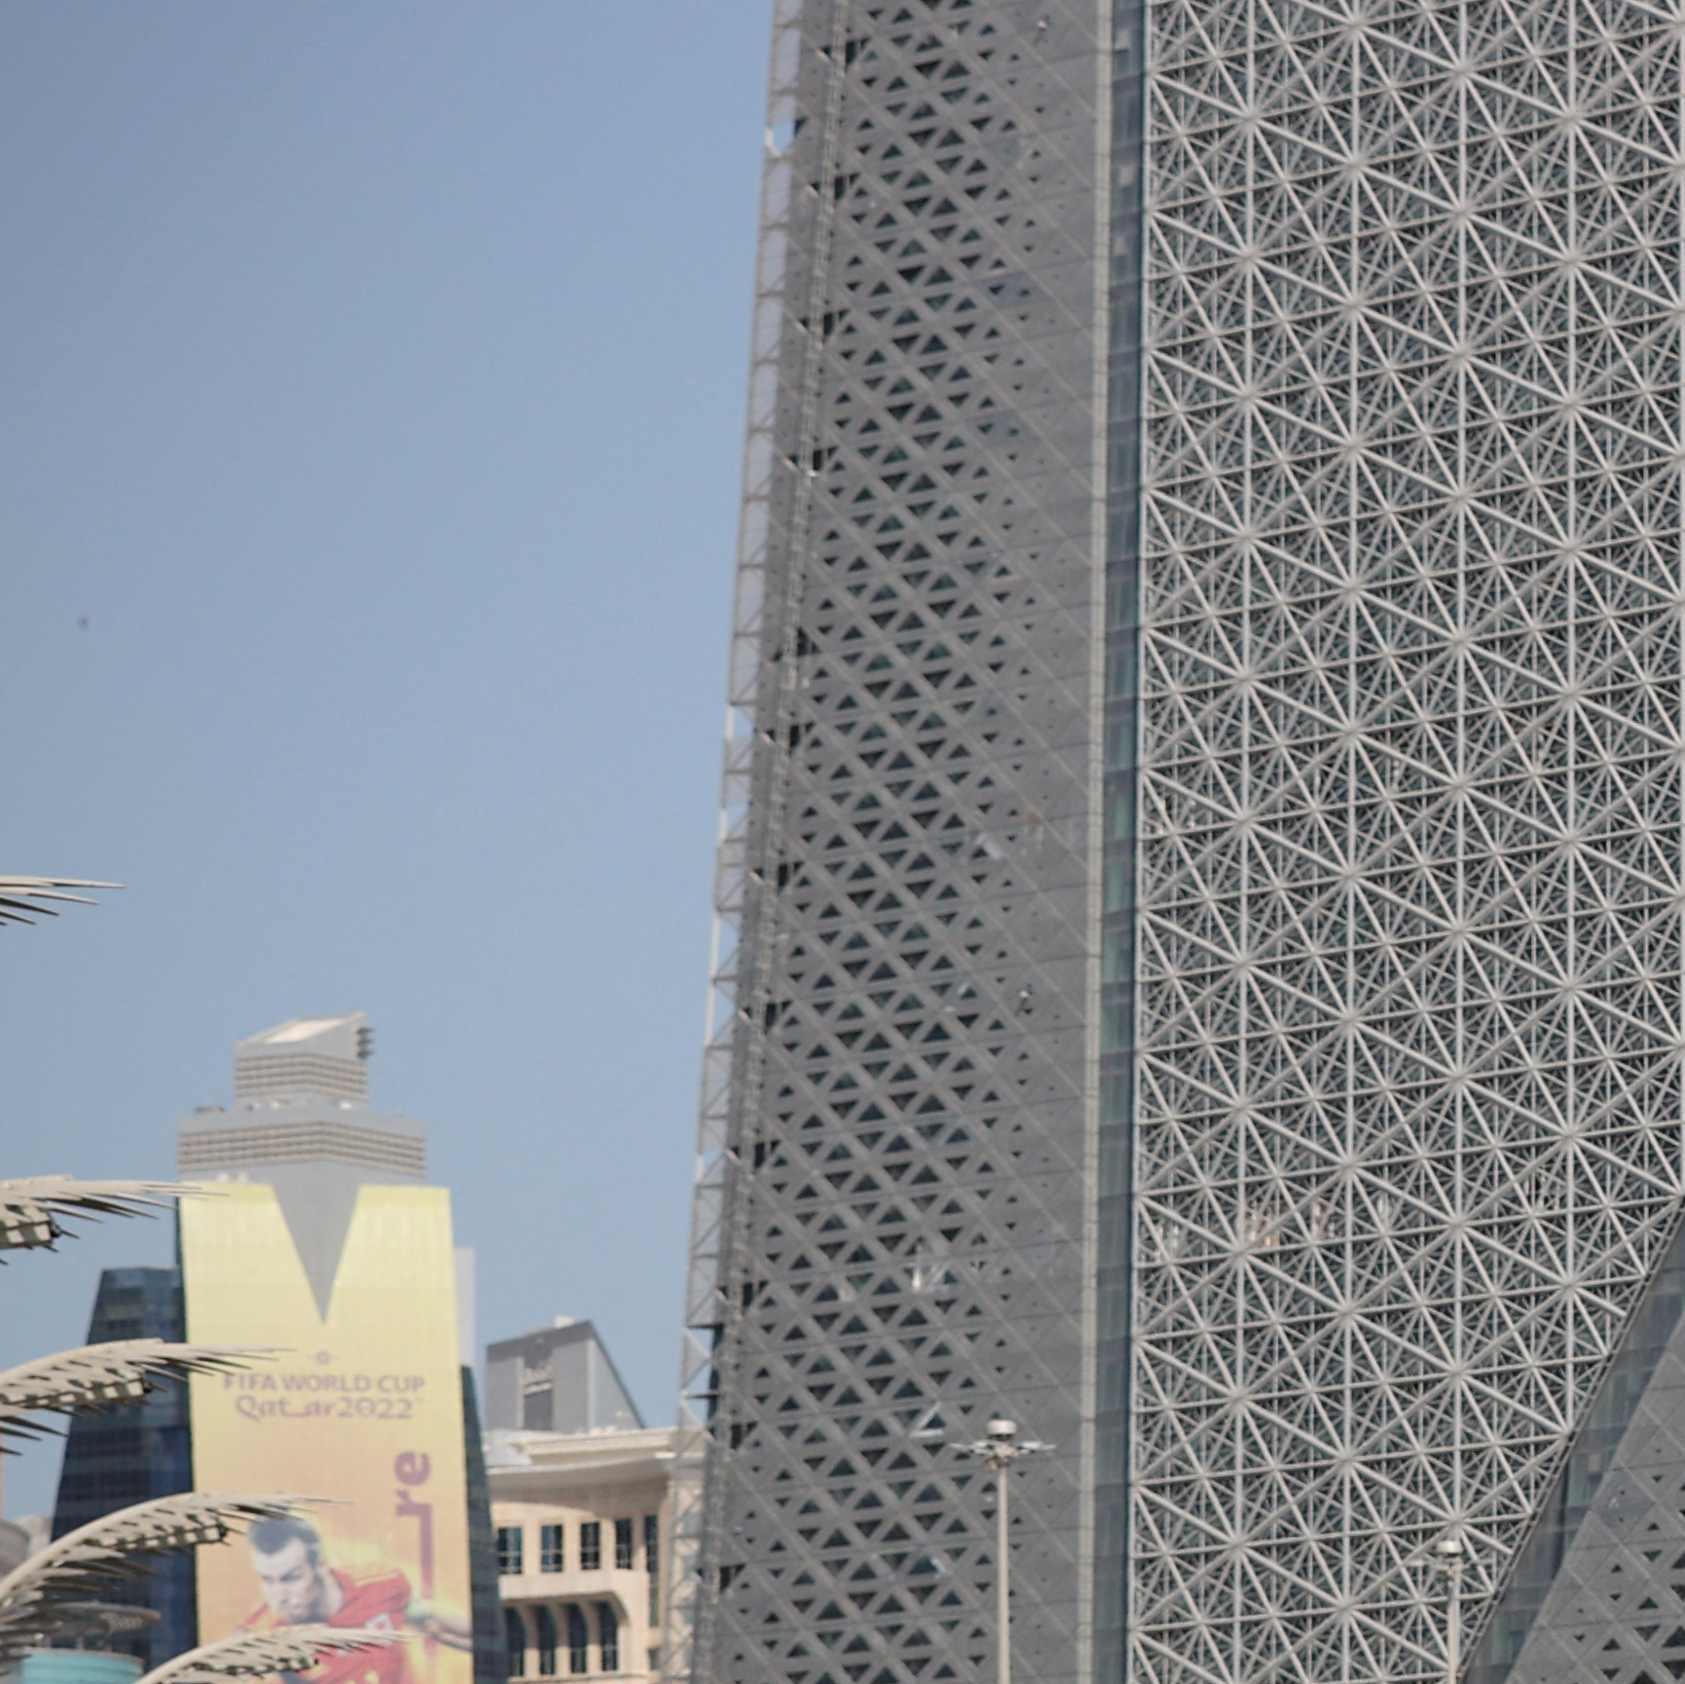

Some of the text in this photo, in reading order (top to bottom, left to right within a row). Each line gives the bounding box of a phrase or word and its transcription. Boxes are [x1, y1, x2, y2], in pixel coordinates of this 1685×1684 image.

[223, 1374, 425, 1392] FIFA WORLD CUP
